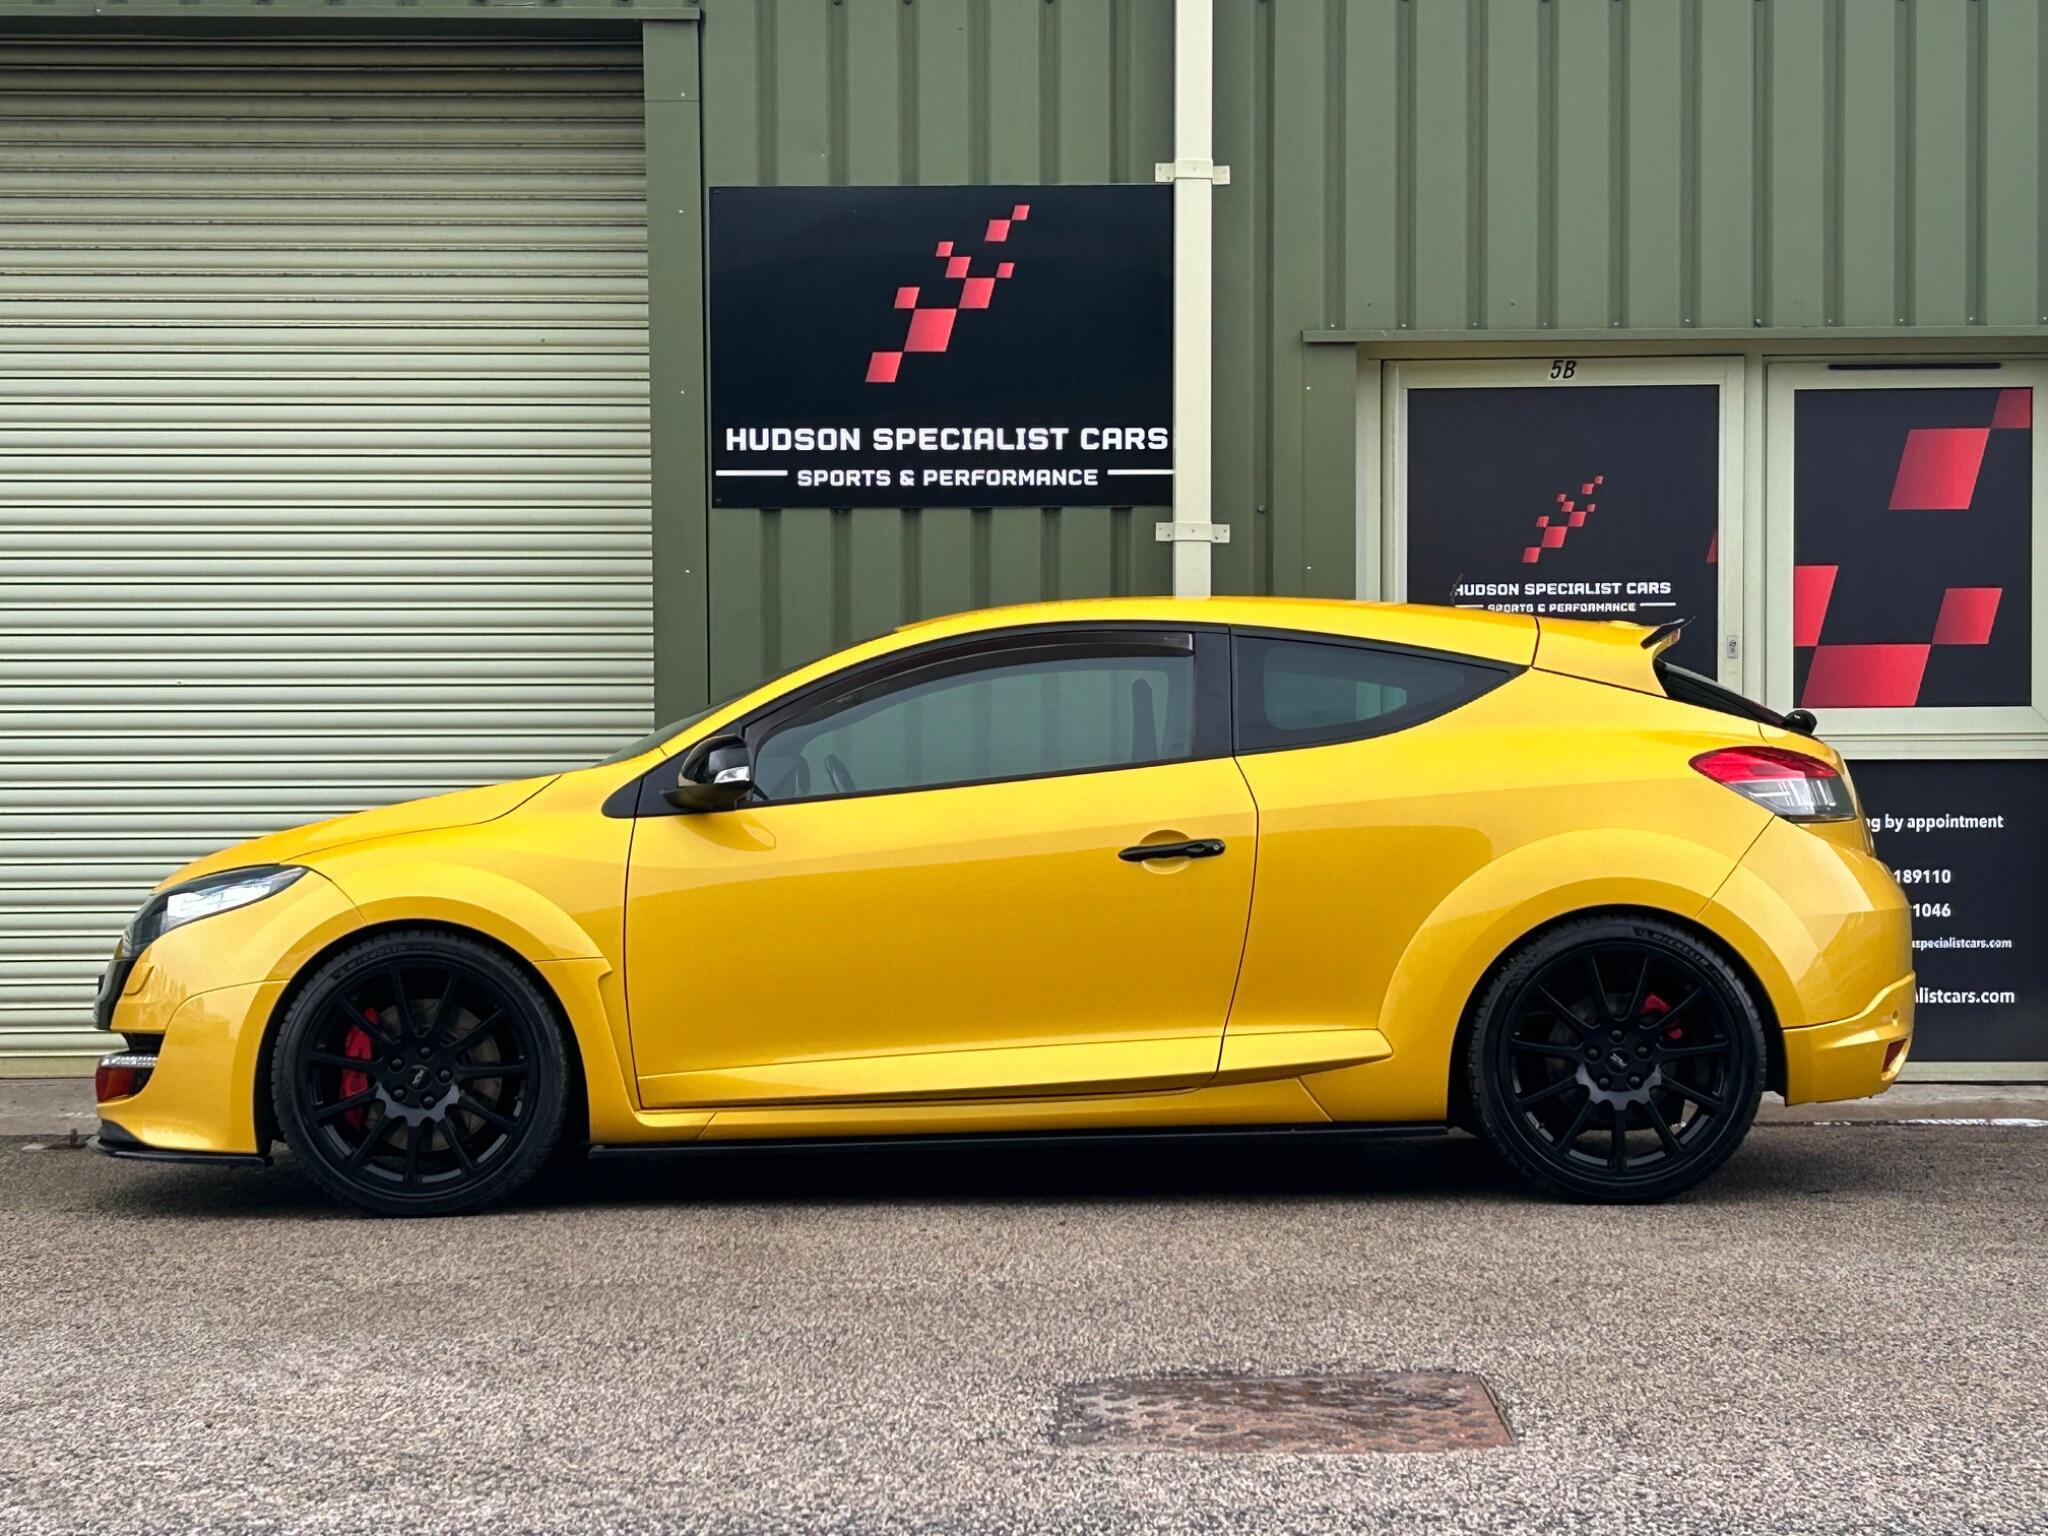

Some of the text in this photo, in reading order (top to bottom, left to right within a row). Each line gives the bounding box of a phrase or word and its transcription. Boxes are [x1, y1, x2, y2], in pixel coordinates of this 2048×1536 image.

[1550, 360, 1577, 379] 5B
[726, 427, 1169, 451] HUDSON SPECIALIST CARS
[797, 468, 1099, 487] SPORTS & PERFORMANCE
[1455, 581, 1672, 596] HUDSON SPECIALIST CARS
[1487, 603, 1534, 613] SPORTS
[1548, 602, 1637, 613] PERFORMANCE
[1884, 813, 1904, 833] by
[1906, 813, 2004, 833] appointment
[1893, 869, 1952, 884] 189110
